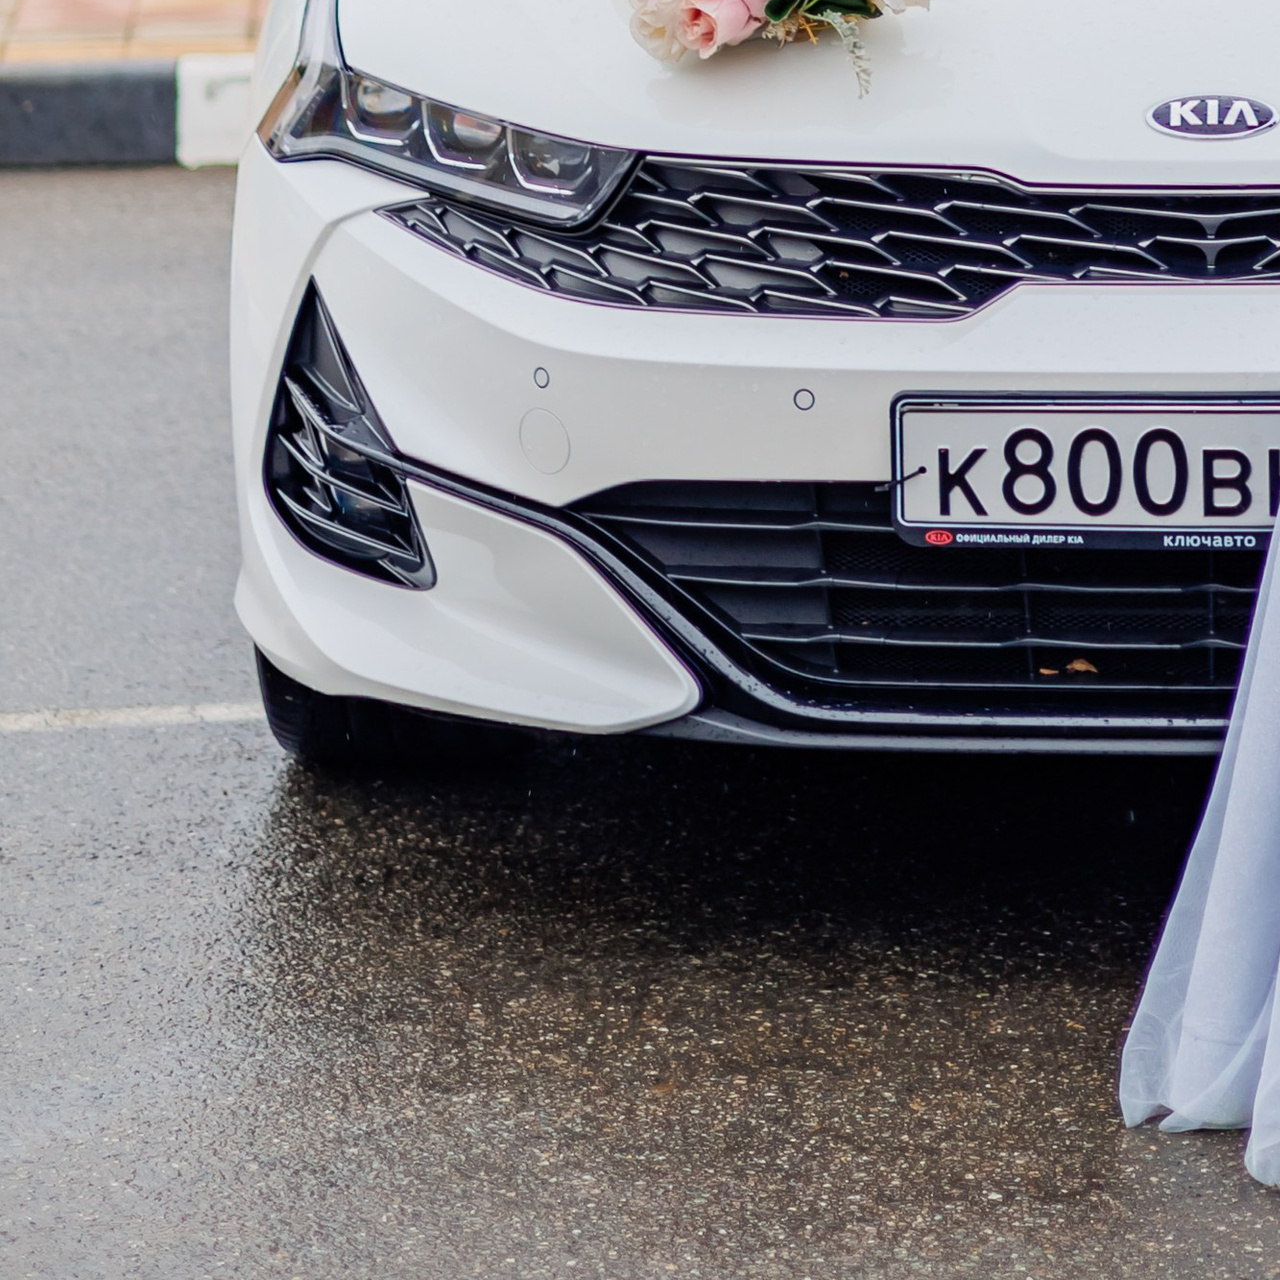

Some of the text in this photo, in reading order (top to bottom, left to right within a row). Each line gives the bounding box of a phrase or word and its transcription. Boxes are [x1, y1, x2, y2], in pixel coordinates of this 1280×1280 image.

[1169, 99, 1259, 127] KIA
[955, 533, 1085, 545] ОФИЦИАЛЬНЫЙ ДИЛЕР KIA
